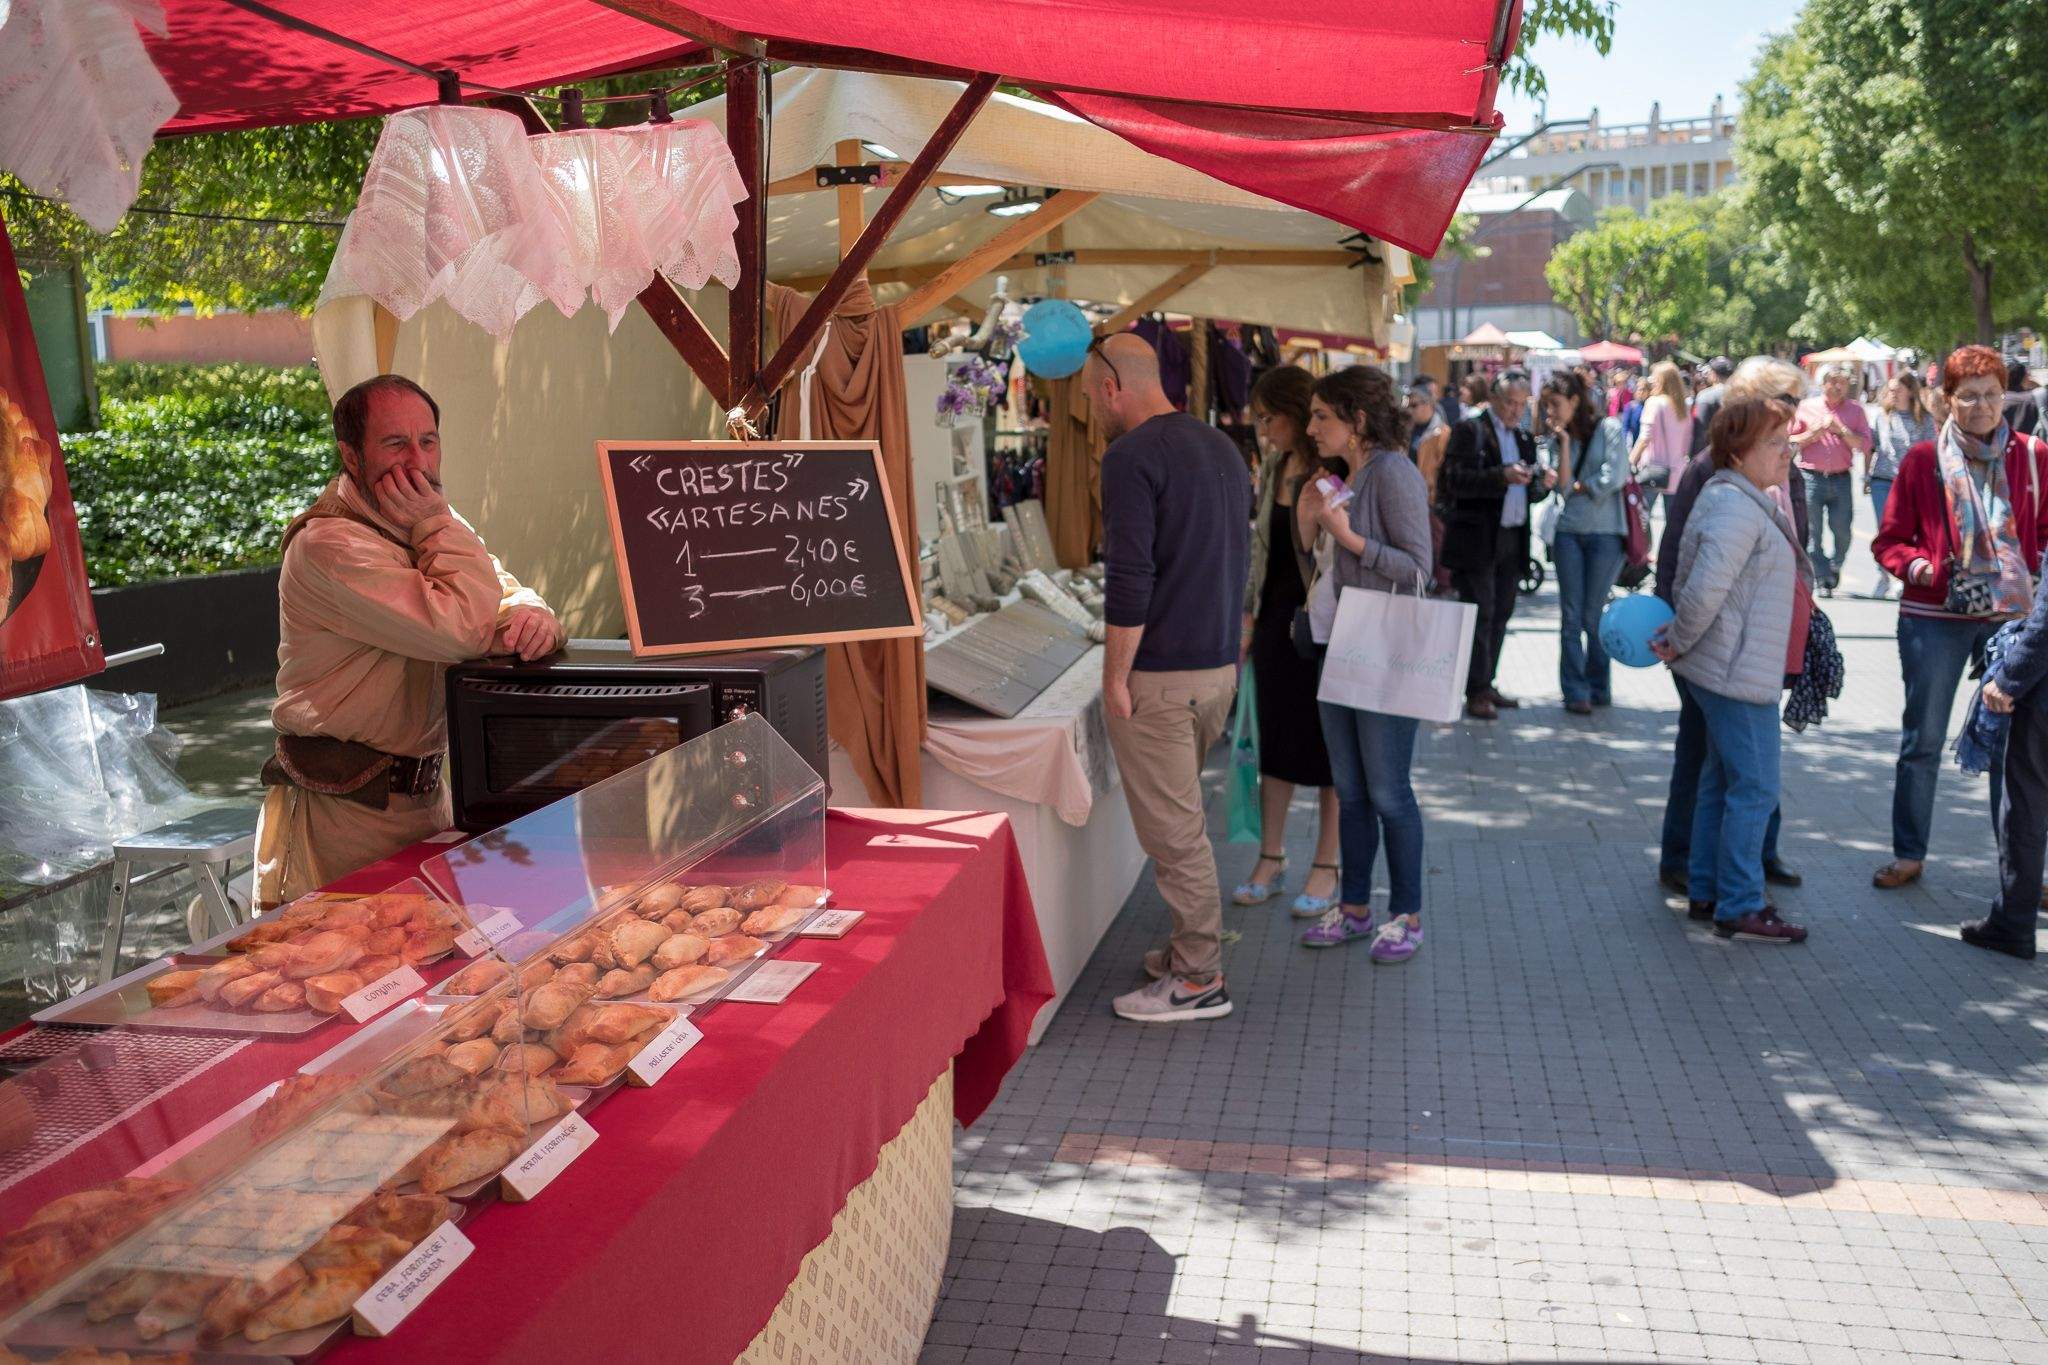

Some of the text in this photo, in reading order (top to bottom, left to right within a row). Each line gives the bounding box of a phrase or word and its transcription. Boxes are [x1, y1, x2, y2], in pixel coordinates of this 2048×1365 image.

[675, 540, 697, 576] 1
[683, 585, 705, 619] 3
[519, 1152, 543, 1174] PERNIL
